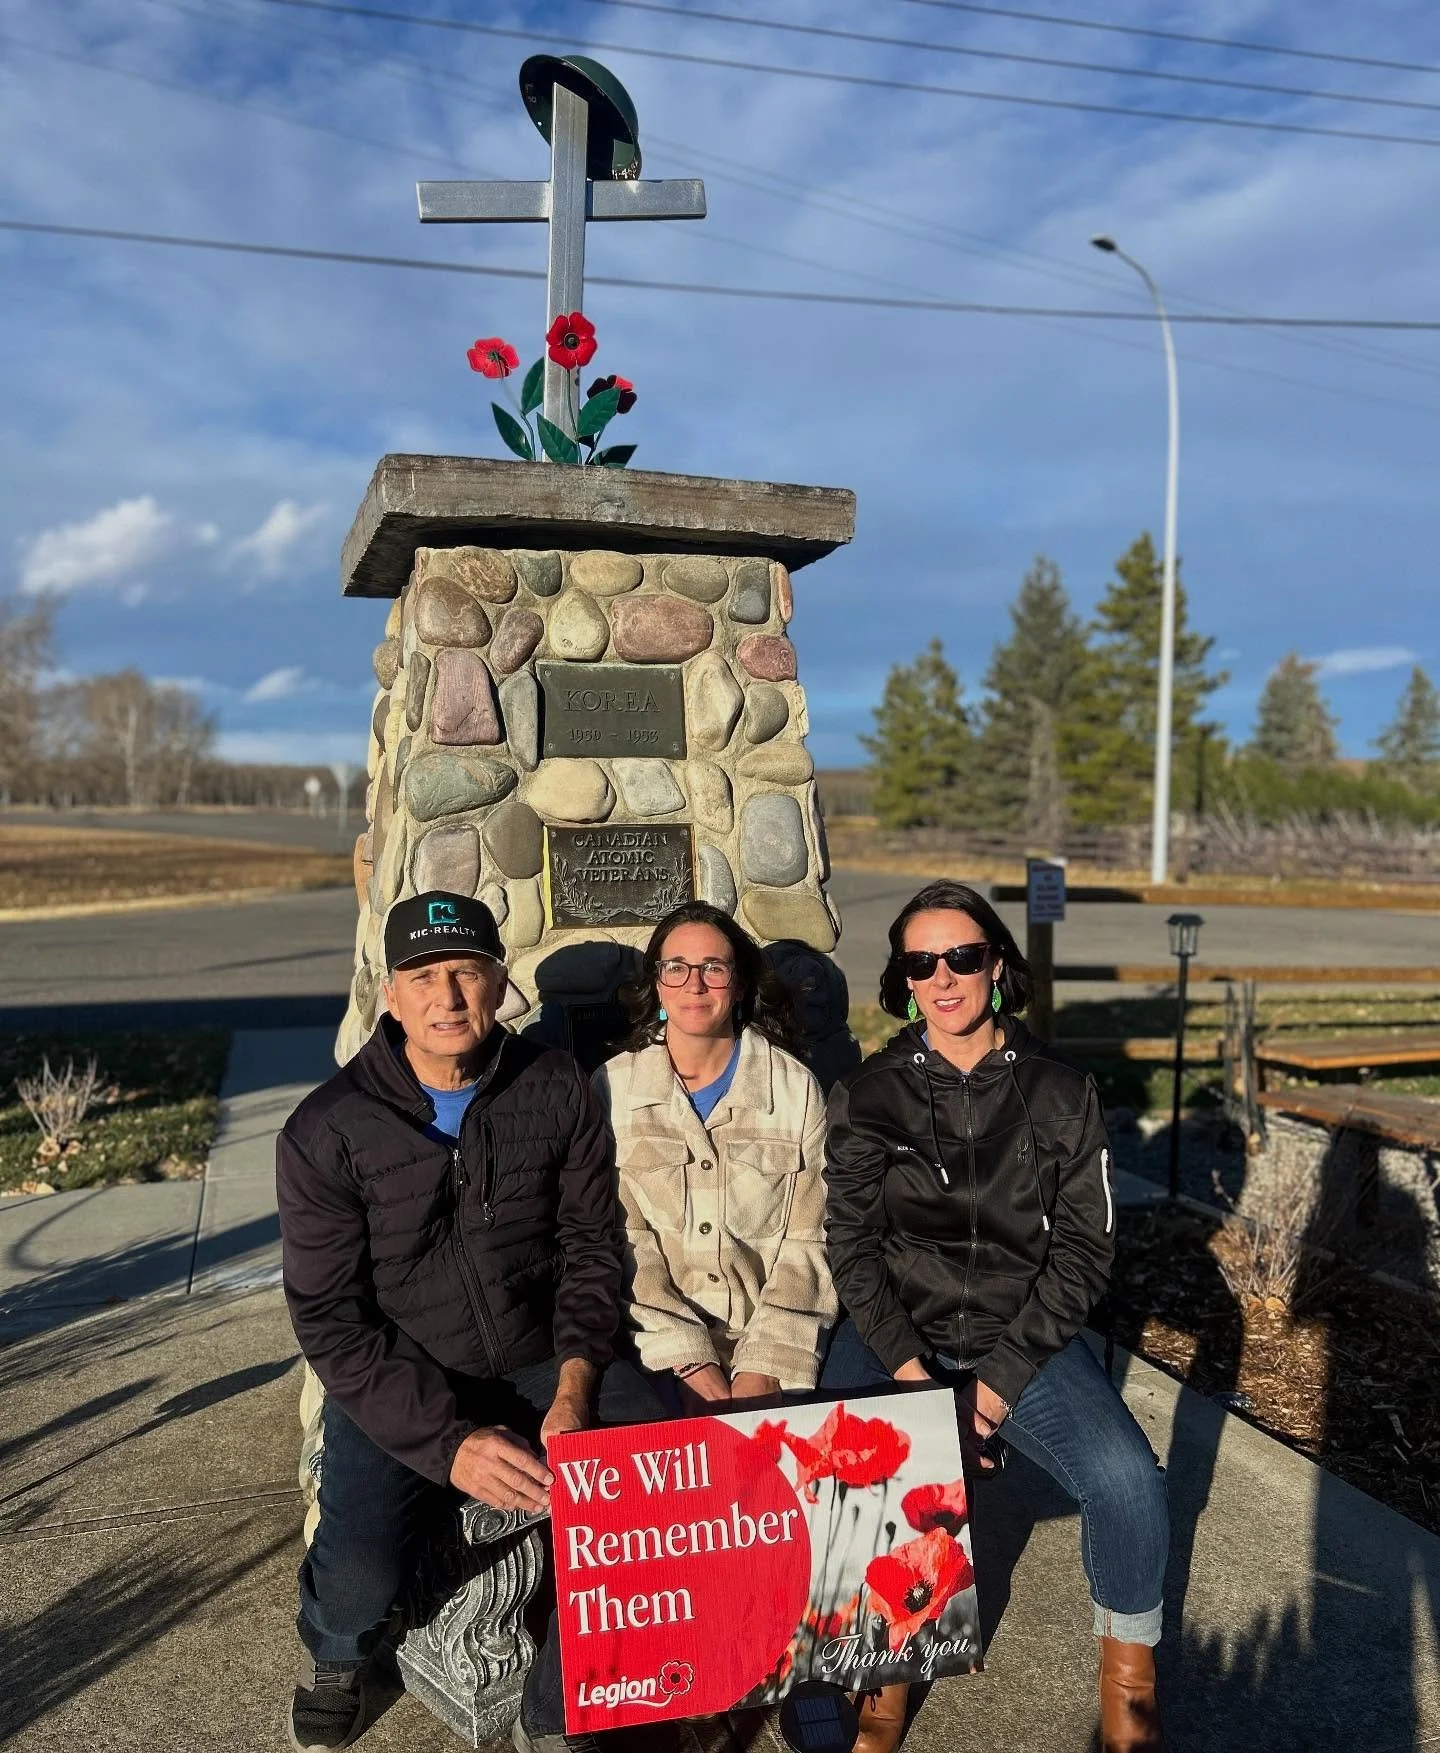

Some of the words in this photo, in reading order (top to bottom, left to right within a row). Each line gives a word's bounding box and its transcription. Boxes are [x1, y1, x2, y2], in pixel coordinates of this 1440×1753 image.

[563, 689, 660, 713] KOREA
[568, 728, 602, 743] 1950
[627, 728, 659, 744] 1953
[572, 832, 669, 849] CANADIAN
[587, 850, 655, 866] ATOMIC
[575, 867, 670, 883] VETERANS
[558, 1457, 621, 1505] We
[631, 1440, 712, 1497] Will
[565, 1502, 801, 1572] Remember
[568, 1584, 695, 1636] Them
[821, 1632, 914, 1675] Thank
[920, 1636, 971, 1675] you
[578, 1676, 657, 1710] Legion
